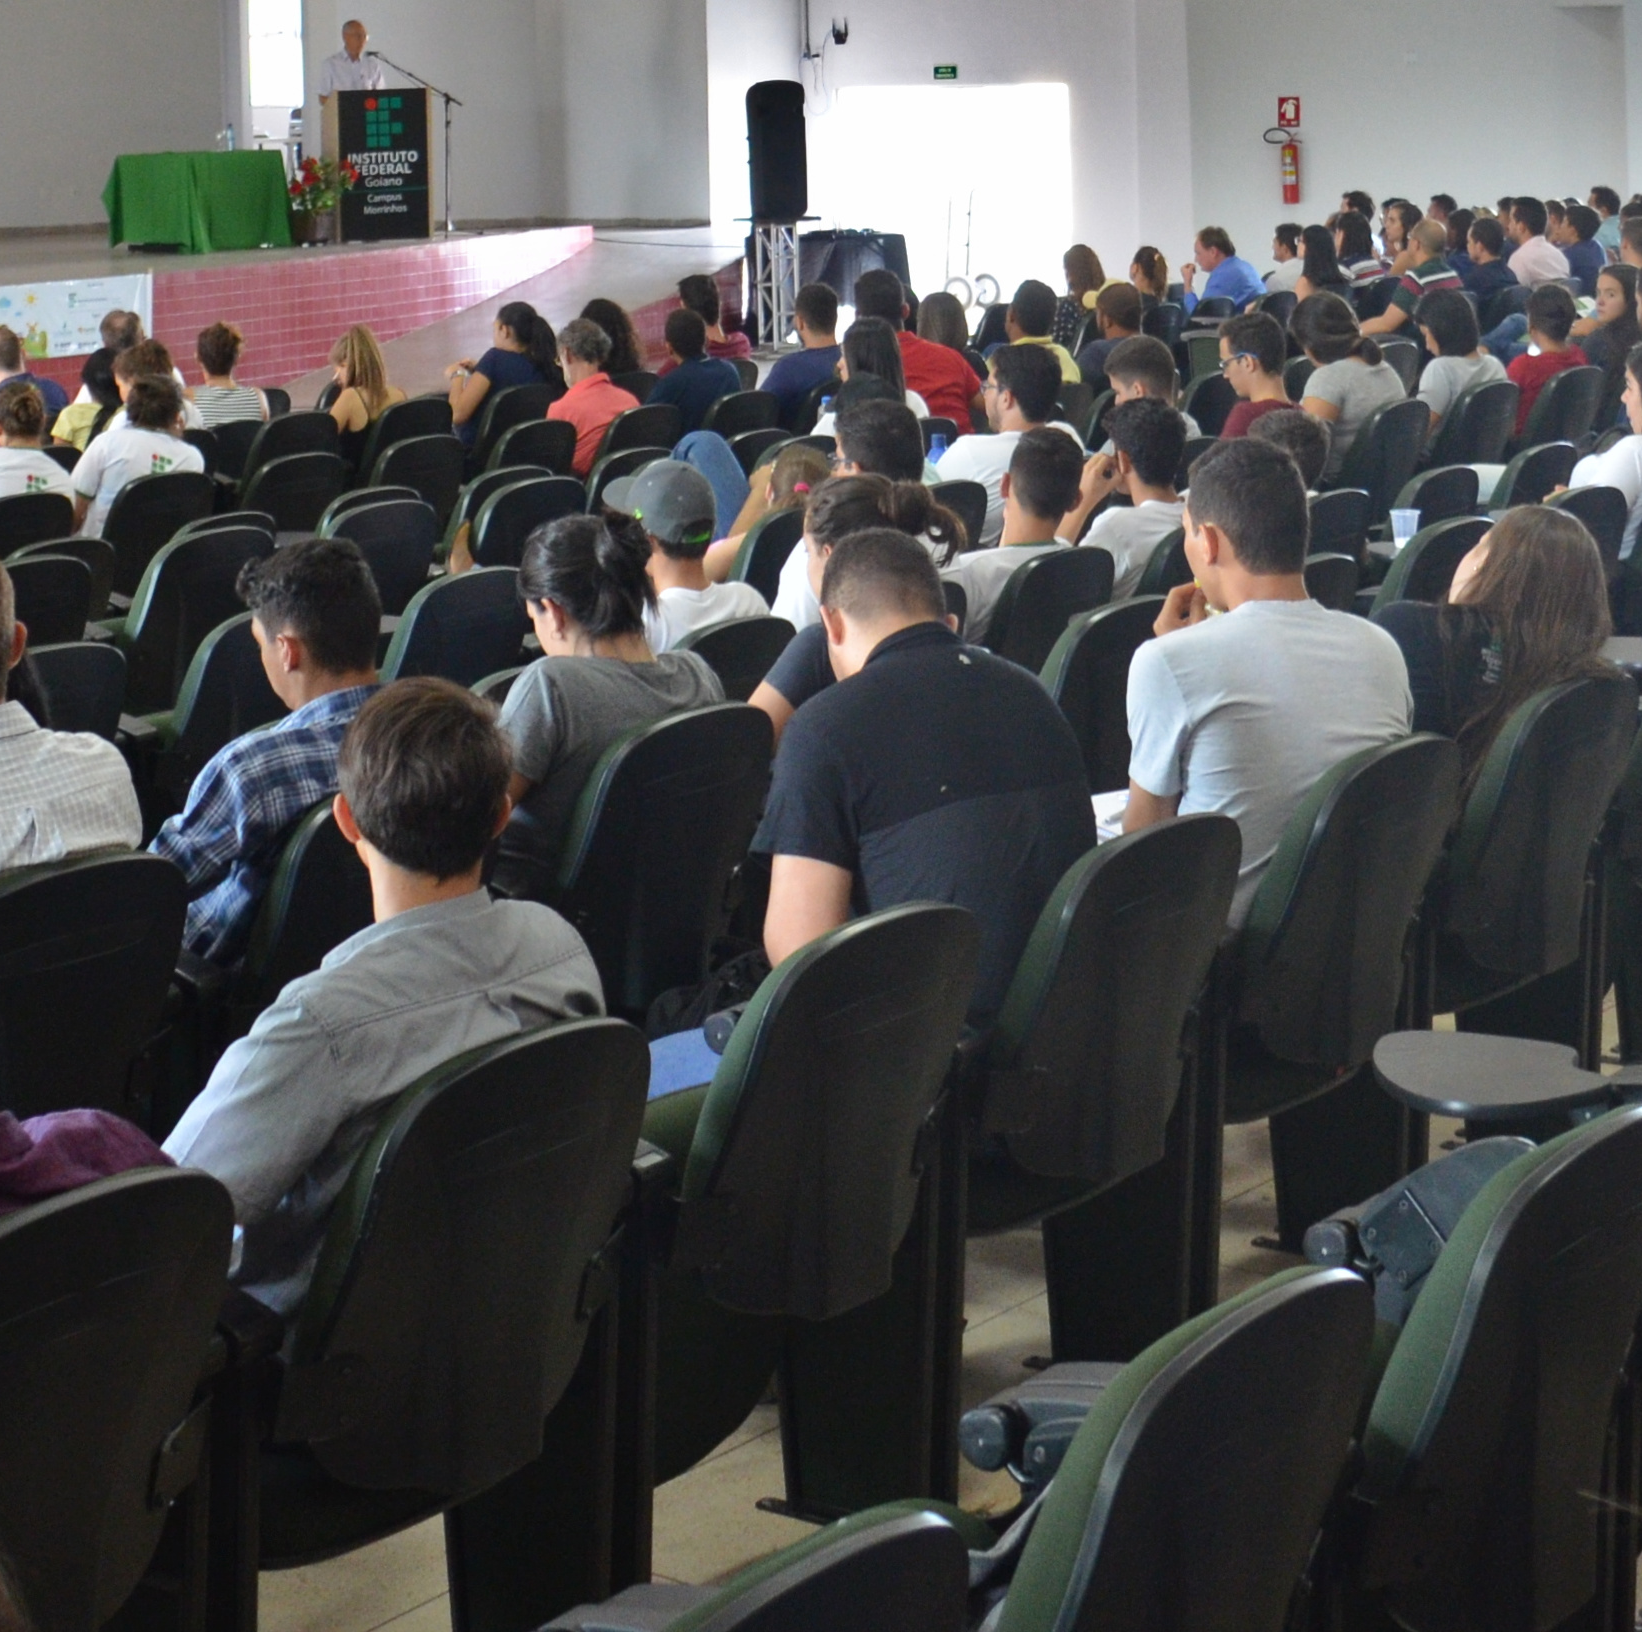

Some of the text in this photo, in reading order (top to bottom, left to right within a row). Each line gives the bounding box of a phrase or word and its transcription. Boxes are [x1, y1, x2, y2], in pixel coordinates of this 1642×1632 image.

[347, 150, 419, 164] INSTITUTO
[364, 177, 403, 188] Goiano
[367, 193, 403, 203] Campus
[363, 204, 408, 215] Morrinhos
